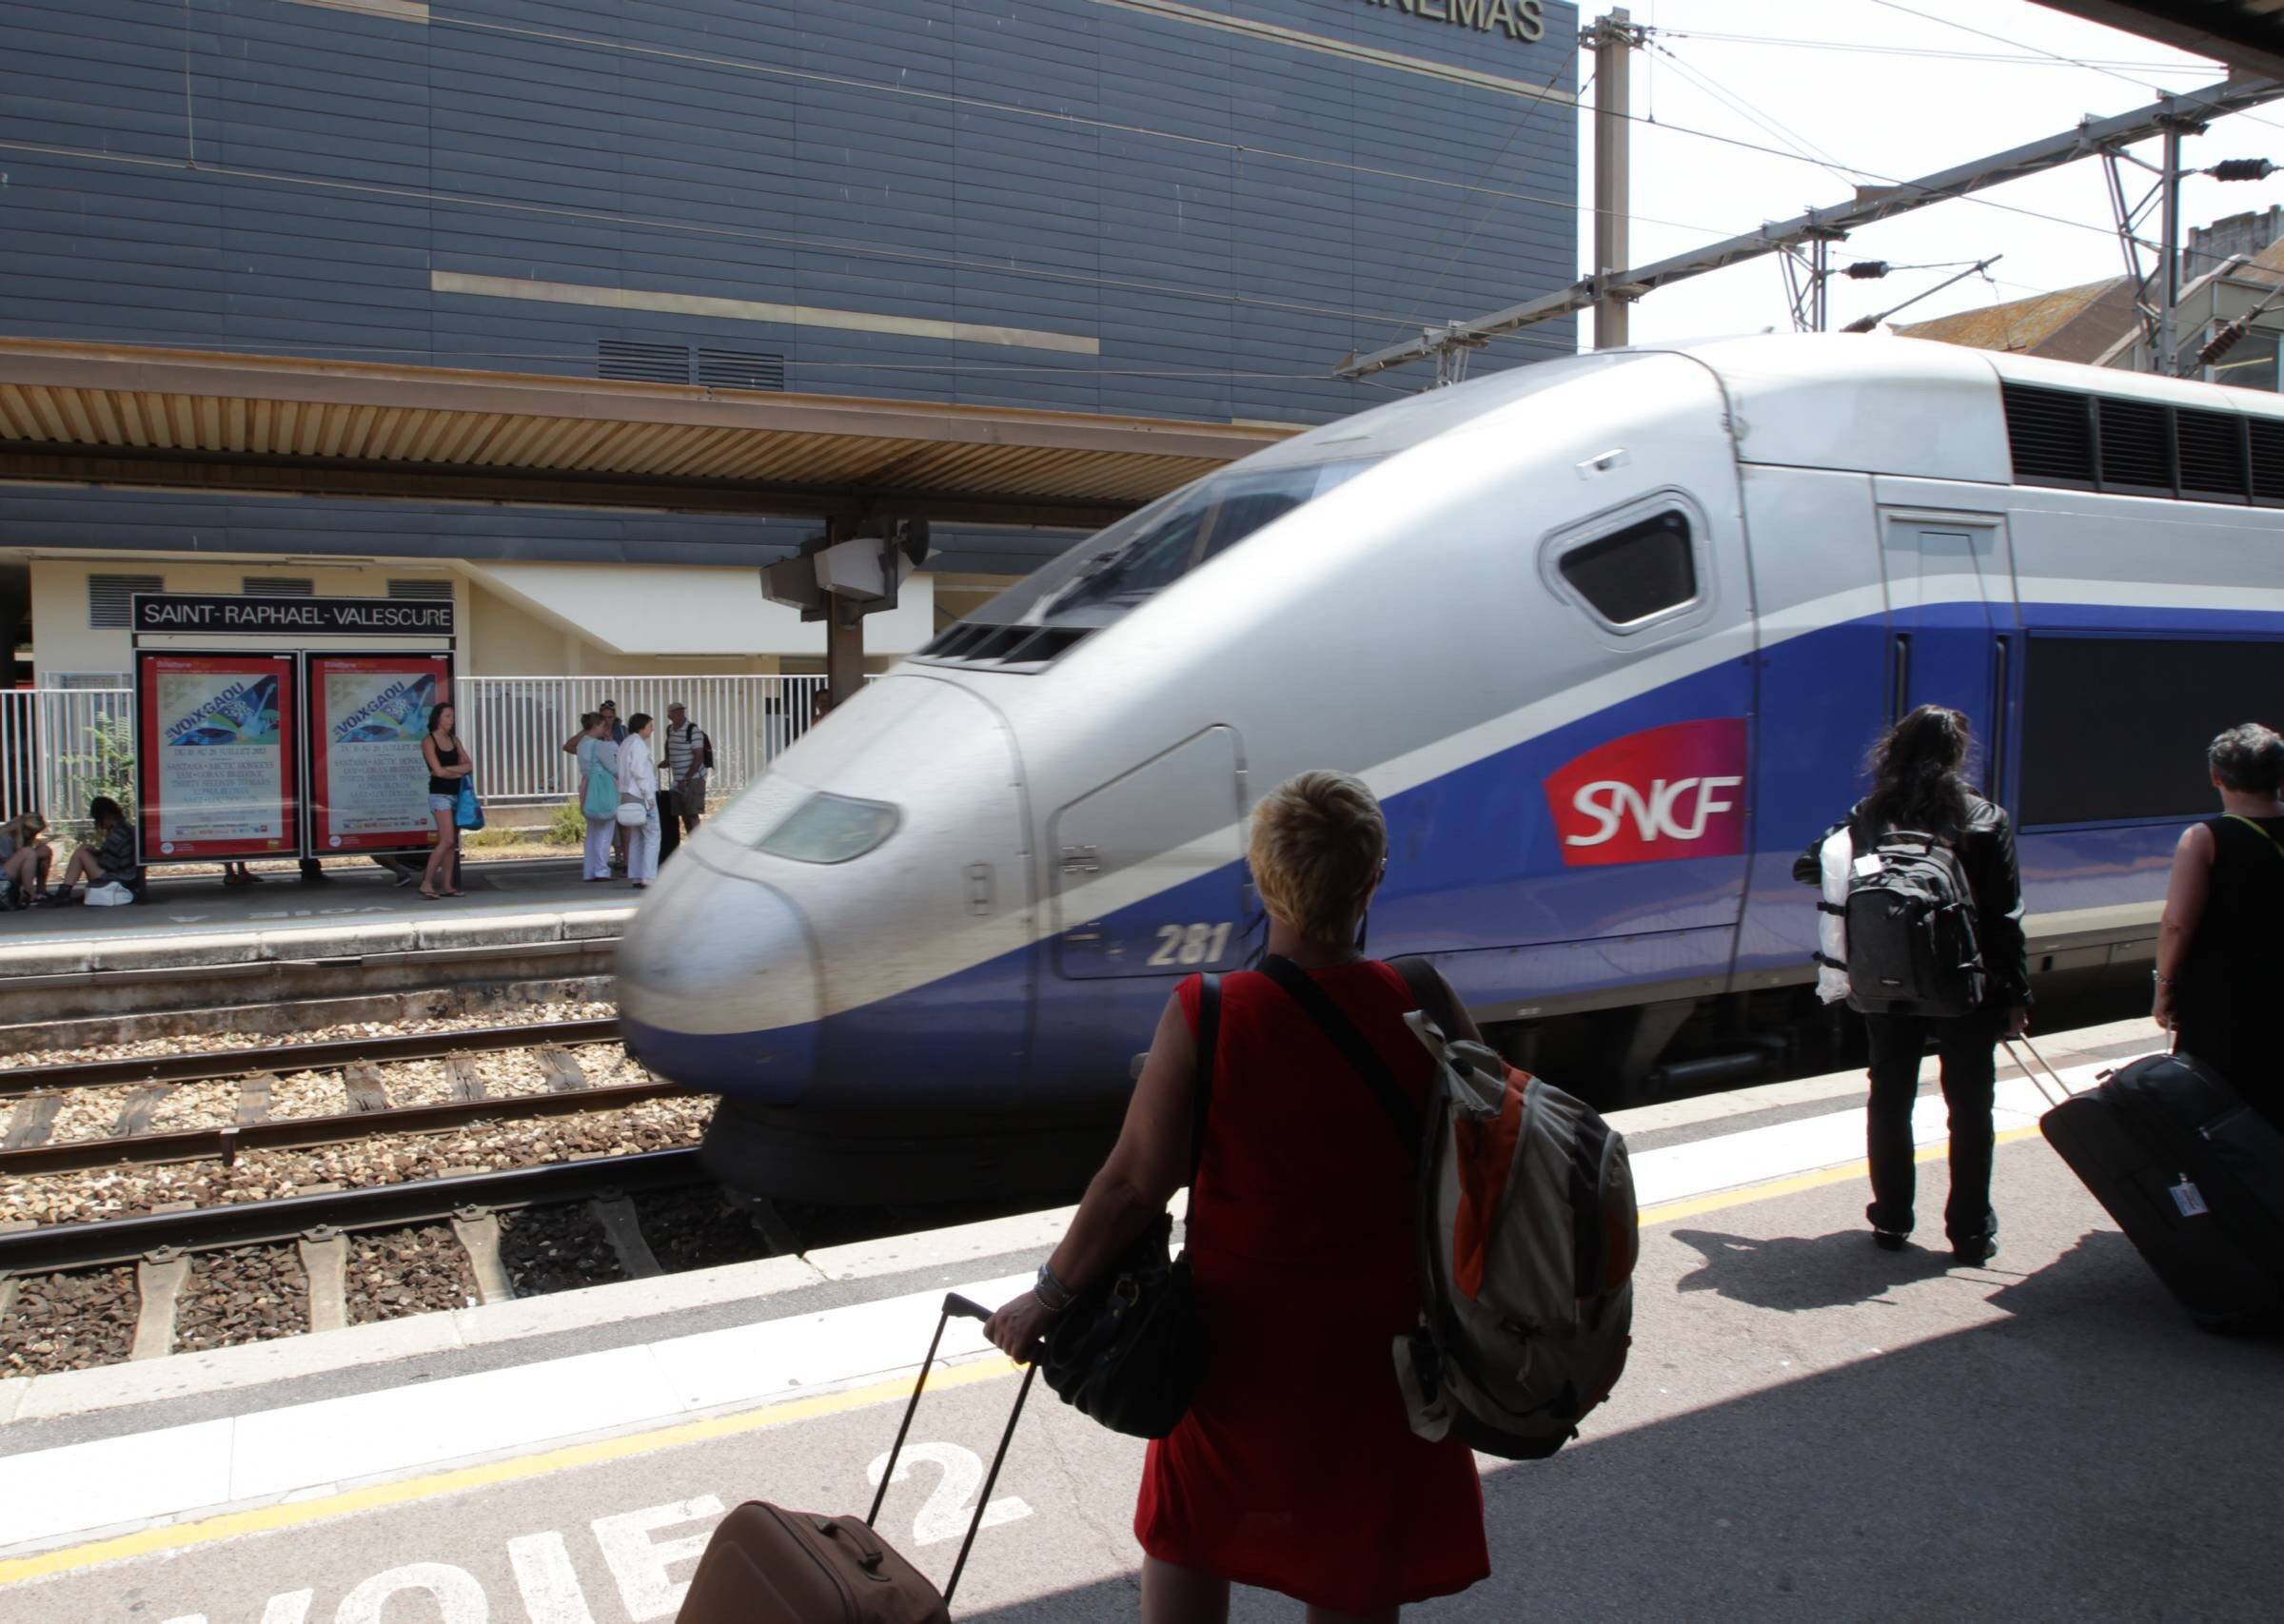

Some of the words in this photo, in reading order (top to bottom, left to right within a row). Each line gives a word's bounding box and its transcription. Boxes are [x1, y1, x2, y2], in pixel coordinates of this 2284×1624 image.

[1565, 776, 1743, 846] SNCF
[1146, 922, 1233, 966] 281
[867, 1441, 1034, 1546] 2
